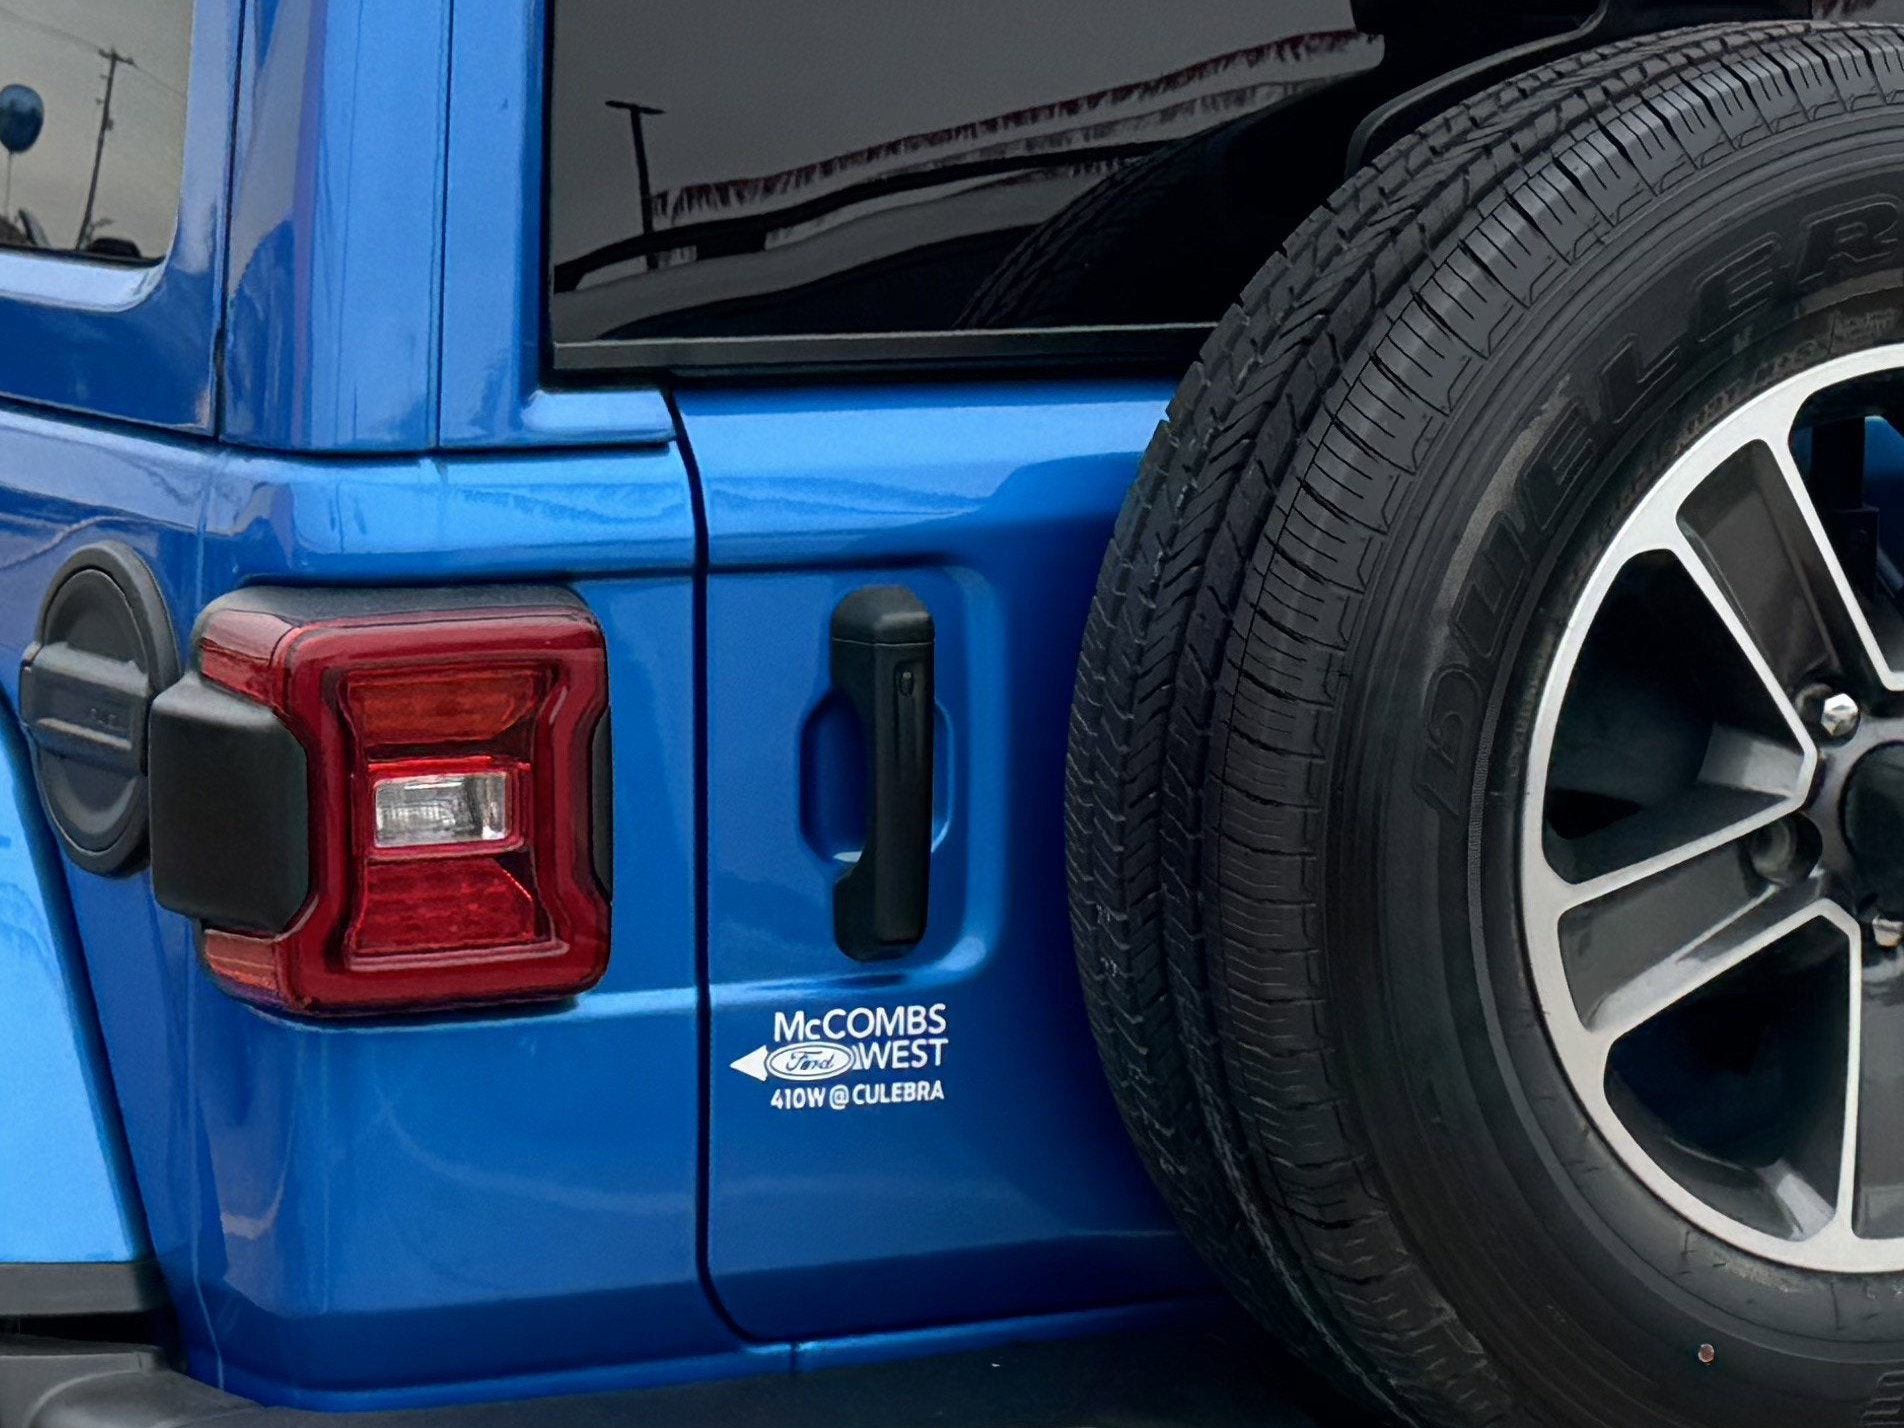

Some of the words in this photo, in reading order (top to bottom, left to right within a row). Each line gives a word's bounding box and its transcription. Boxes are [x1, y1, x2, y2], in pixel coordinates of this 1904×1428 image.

[773, 1003, 947, 1042] McCOMBS
[785, 1050, 835, 1071] Ford
[858, 1038, 949, 1070] WEST
[770, 1086, 826, 1110] 410W
[852, 1080, 945, 1105] CULEBRA
